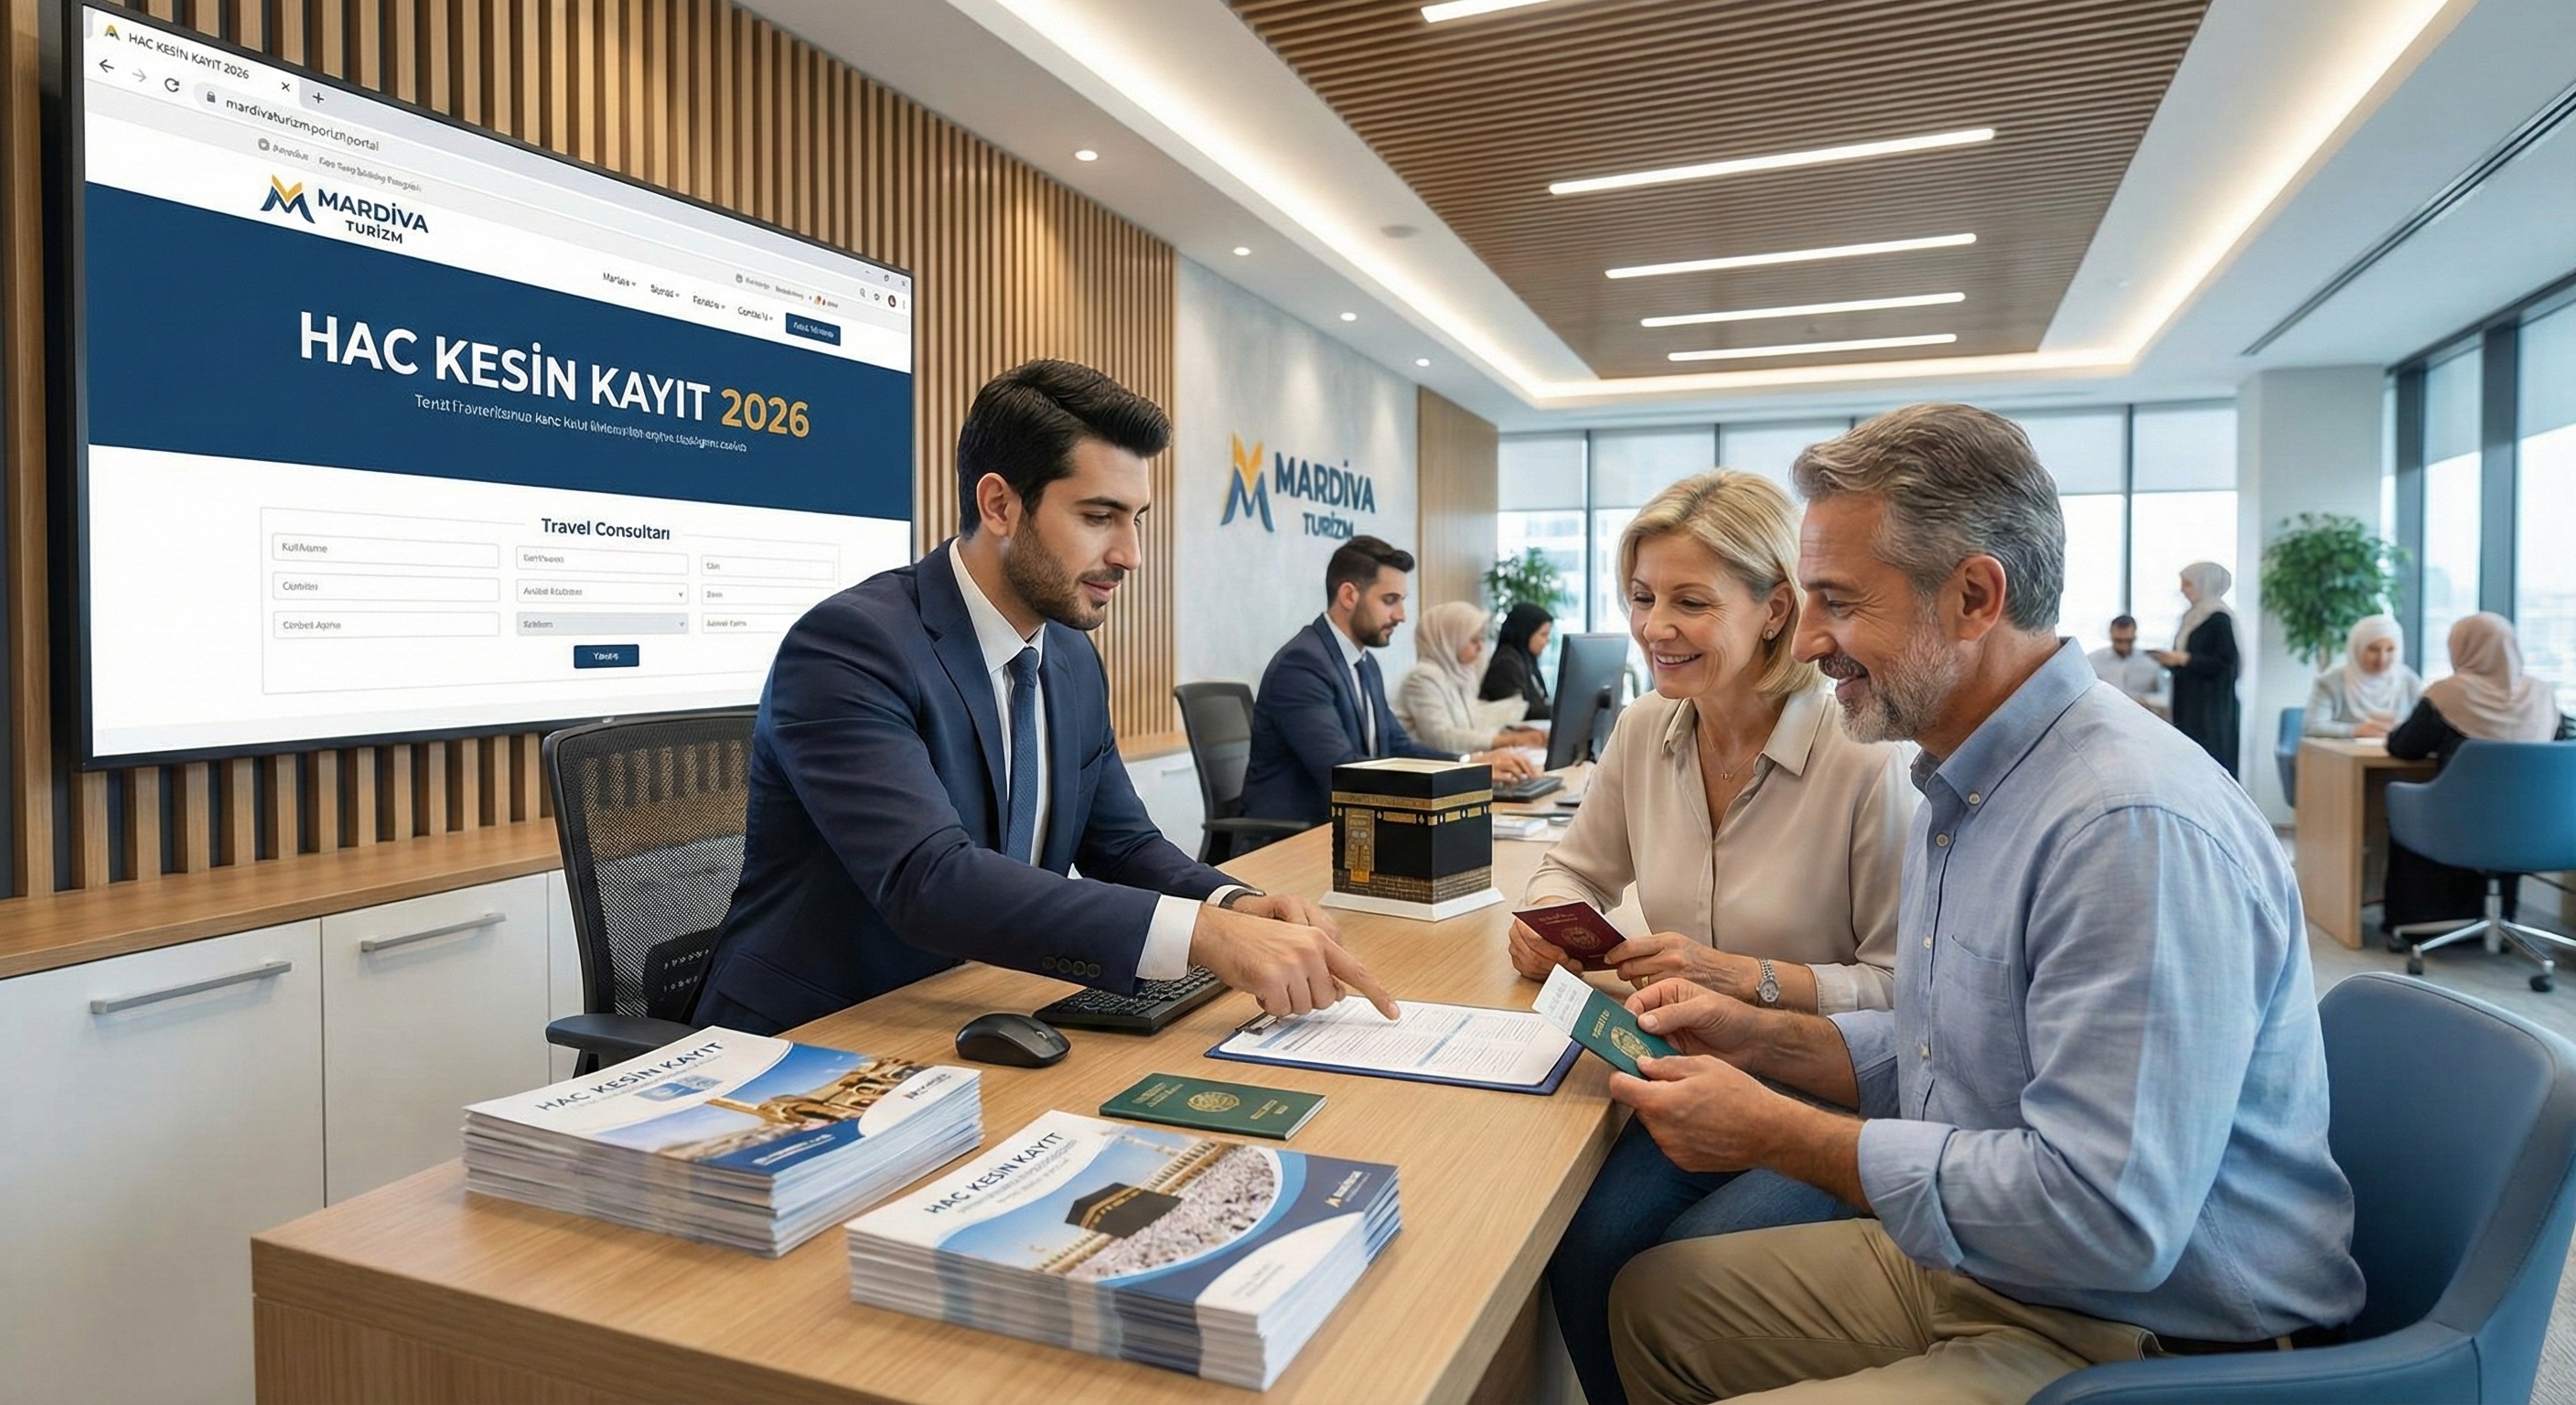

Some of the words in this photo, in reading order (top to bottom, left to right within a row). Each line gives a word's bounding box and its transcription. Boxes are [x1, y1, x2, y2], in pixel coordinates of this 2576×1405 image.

[128, 32, 154, 50] HAC
[156, 41, 188, 61] KESİN
[191, 53, 222, 71] KAYIT
[224, 63, 250, 80] 2026
[318, 188, 430, 234] MARDİVA
[345, 220, 403, 244] TURİZM
[300, 310, 419, 376] HAC
[435, 334, 577, 401] KESİN
[591, 363, 711, 422] KAYIT
[720, 387, 810, 438] 2026
[1274, 452, 1377, 514] MARDİVA
[542, 518, 591, 535] Travel
[1302, 510, 1355, 540] TURİZM
[534, 1091, 591, 1111] HAC
[590, 1067, 662, 1094] KESİN
[660, 1042, 724, 1069] KAYIT
[923, 1191, 971, 1214] HAC
